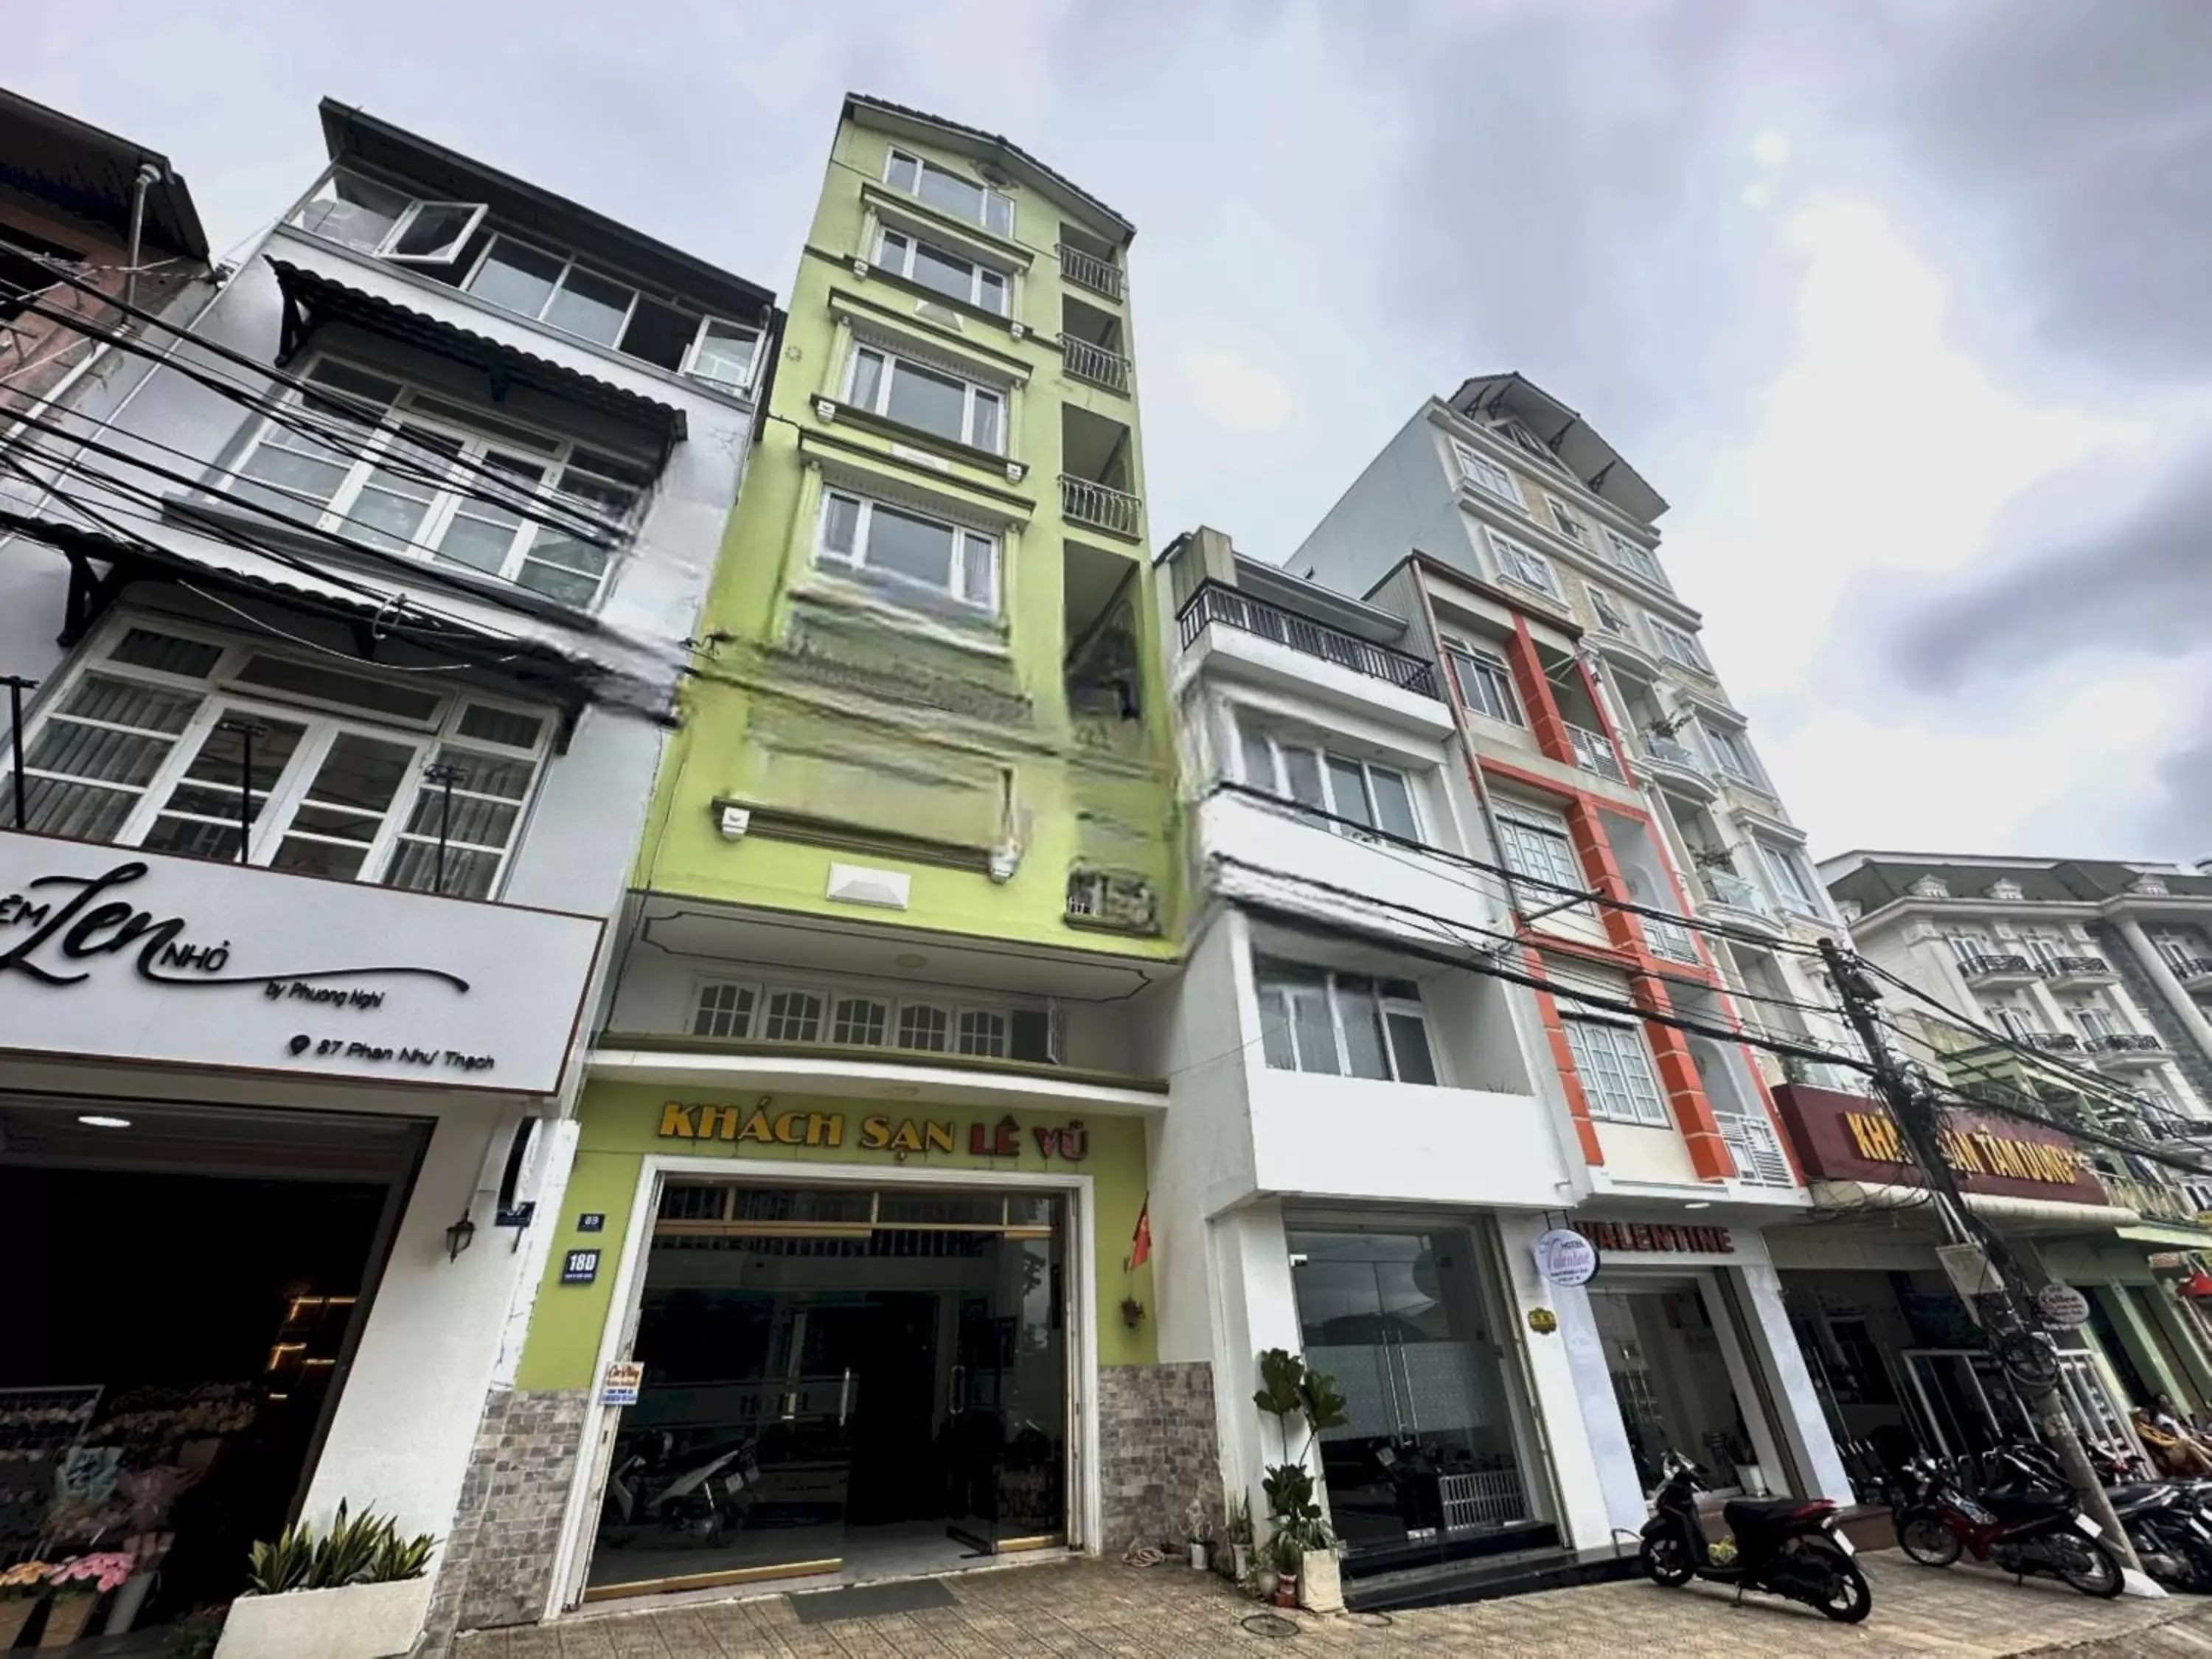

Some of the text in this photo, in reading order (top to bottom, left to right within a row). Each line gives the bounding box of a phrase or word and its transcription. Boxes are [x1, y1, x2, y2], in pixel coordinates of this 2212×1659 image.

[159, 939, 231, 972] NHỎ
[264, 980, 286, 1001] by
[316, 1038, 344, 1056] 87
[345, 1040, 394, 1061] Phan
[658, 1096, 1089, 1162] KHÁCH SẠN LÊ VŨ
[1573, 1221, 1735, 1253] VALENTINE
[569, 1253, 597, 1272] 180
